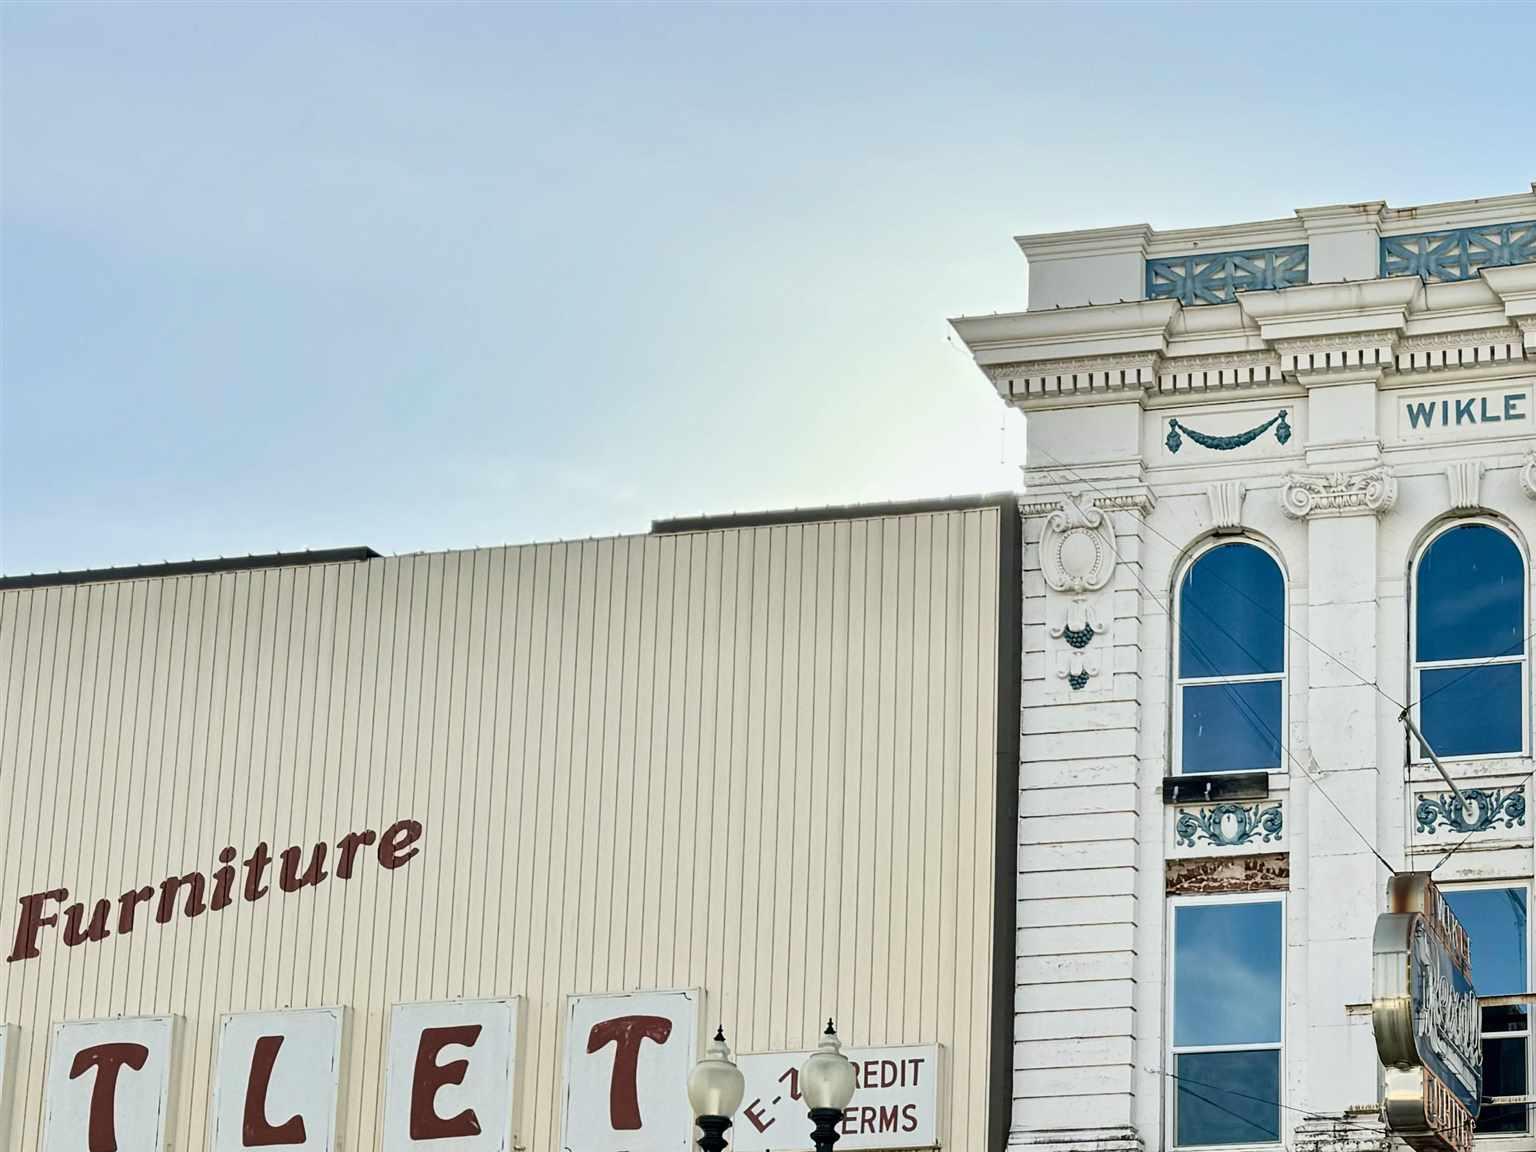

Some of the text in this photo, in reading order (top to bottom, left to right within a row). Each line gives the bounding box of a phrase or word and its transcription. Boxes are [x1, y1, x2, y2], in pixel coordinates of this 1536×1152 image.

[1406, 393, 1526, 429] WIKLE
[7, 819, 423, 962] Furniture
[848, 1059, 925, 1089] REDIT
[841, 1104, 918, 1135] ERMS
